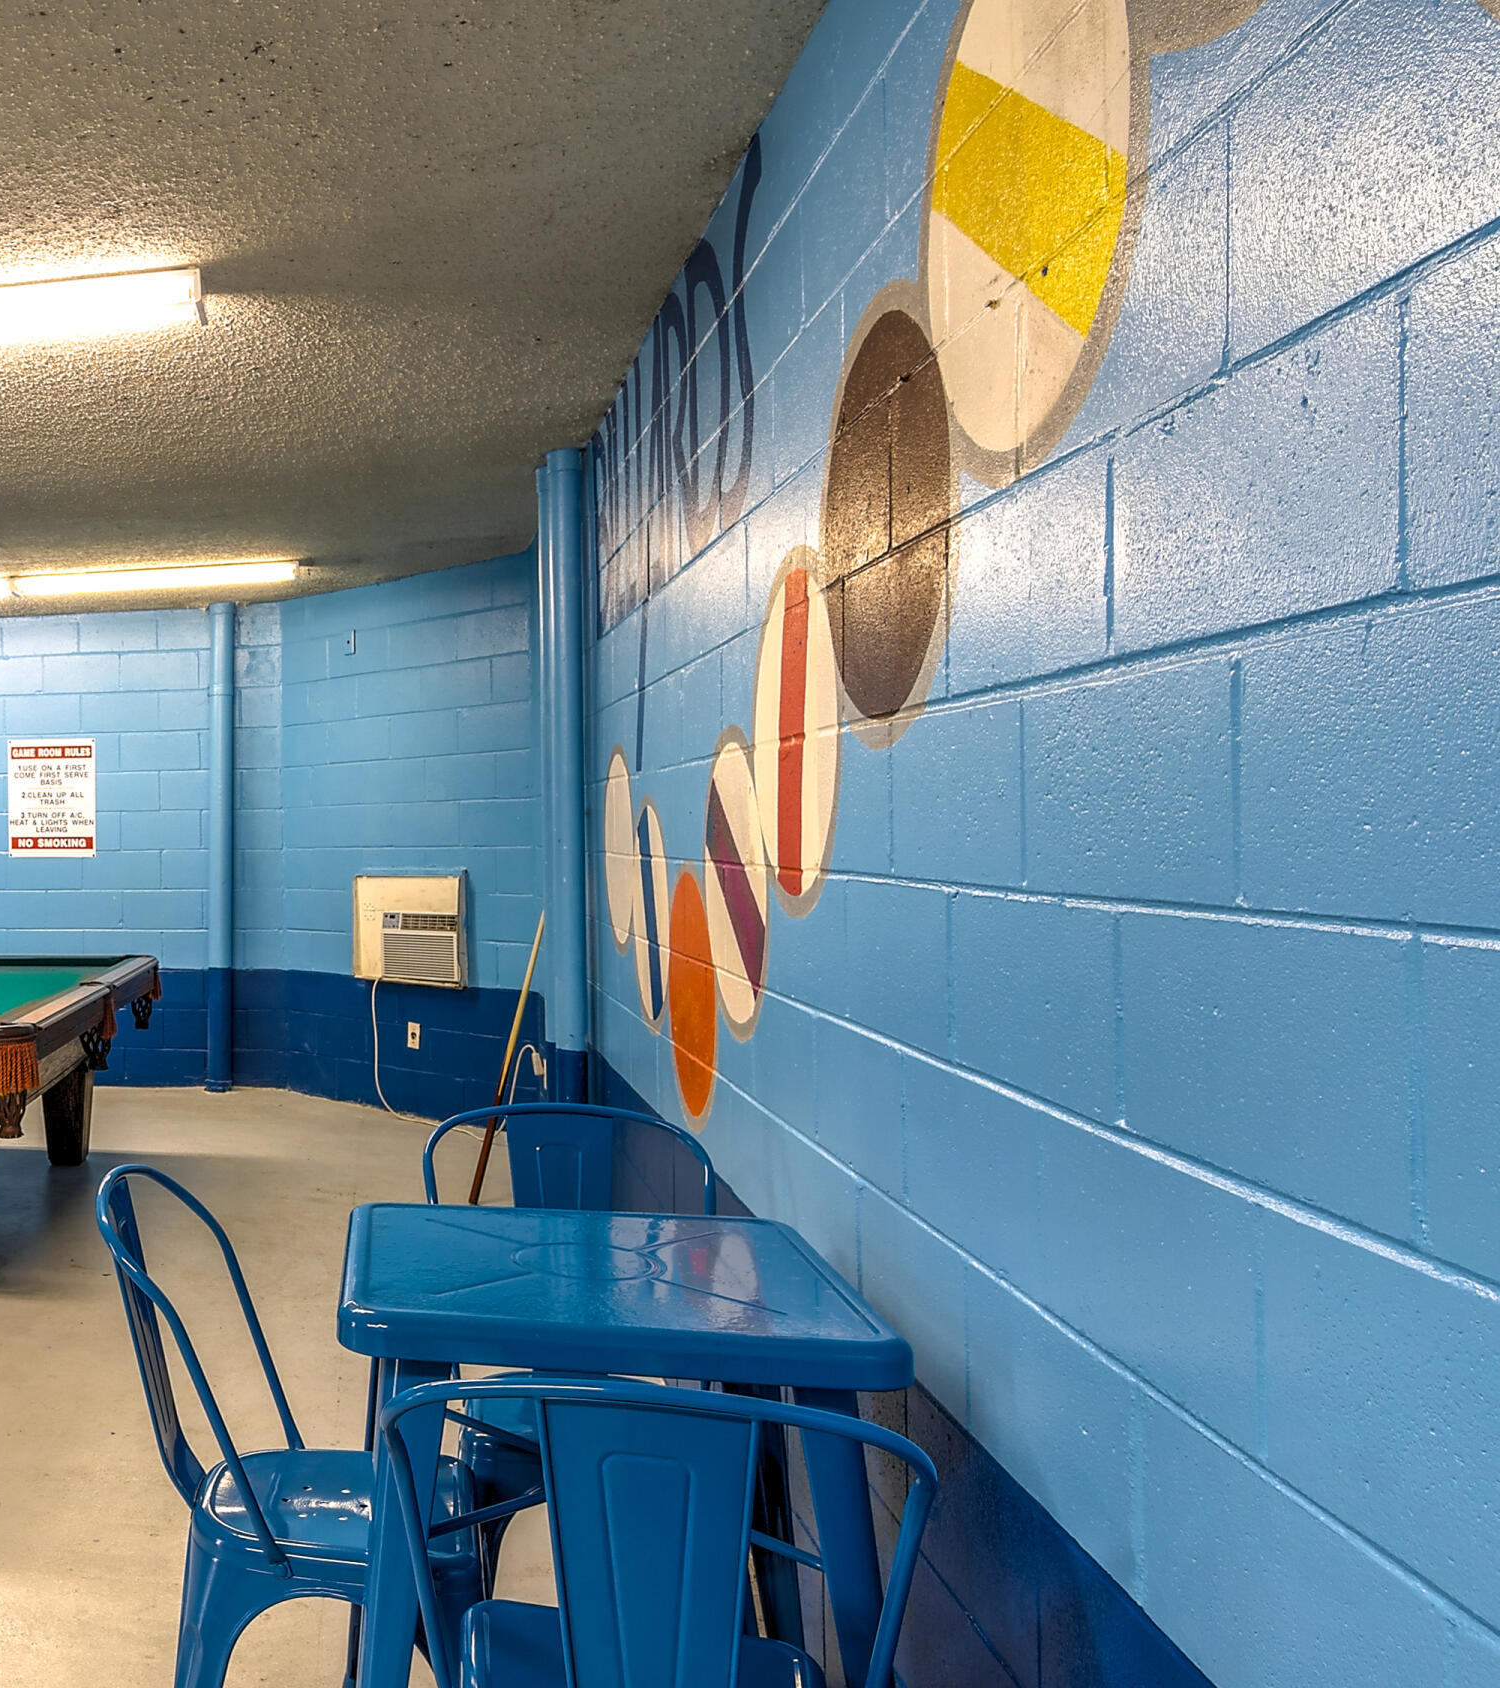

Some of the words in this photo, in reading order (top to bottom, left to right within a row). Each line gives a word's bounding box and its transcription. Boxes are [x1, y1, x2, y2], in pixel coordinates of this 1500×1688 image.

[12, 747, 36, 758] GAME
[37, 747, 62, 757] ROOM
[64, 746, 91, 757] RULES
[17, 838, 34, 848] NO
[37, 838, 87, 848] SMOKING
